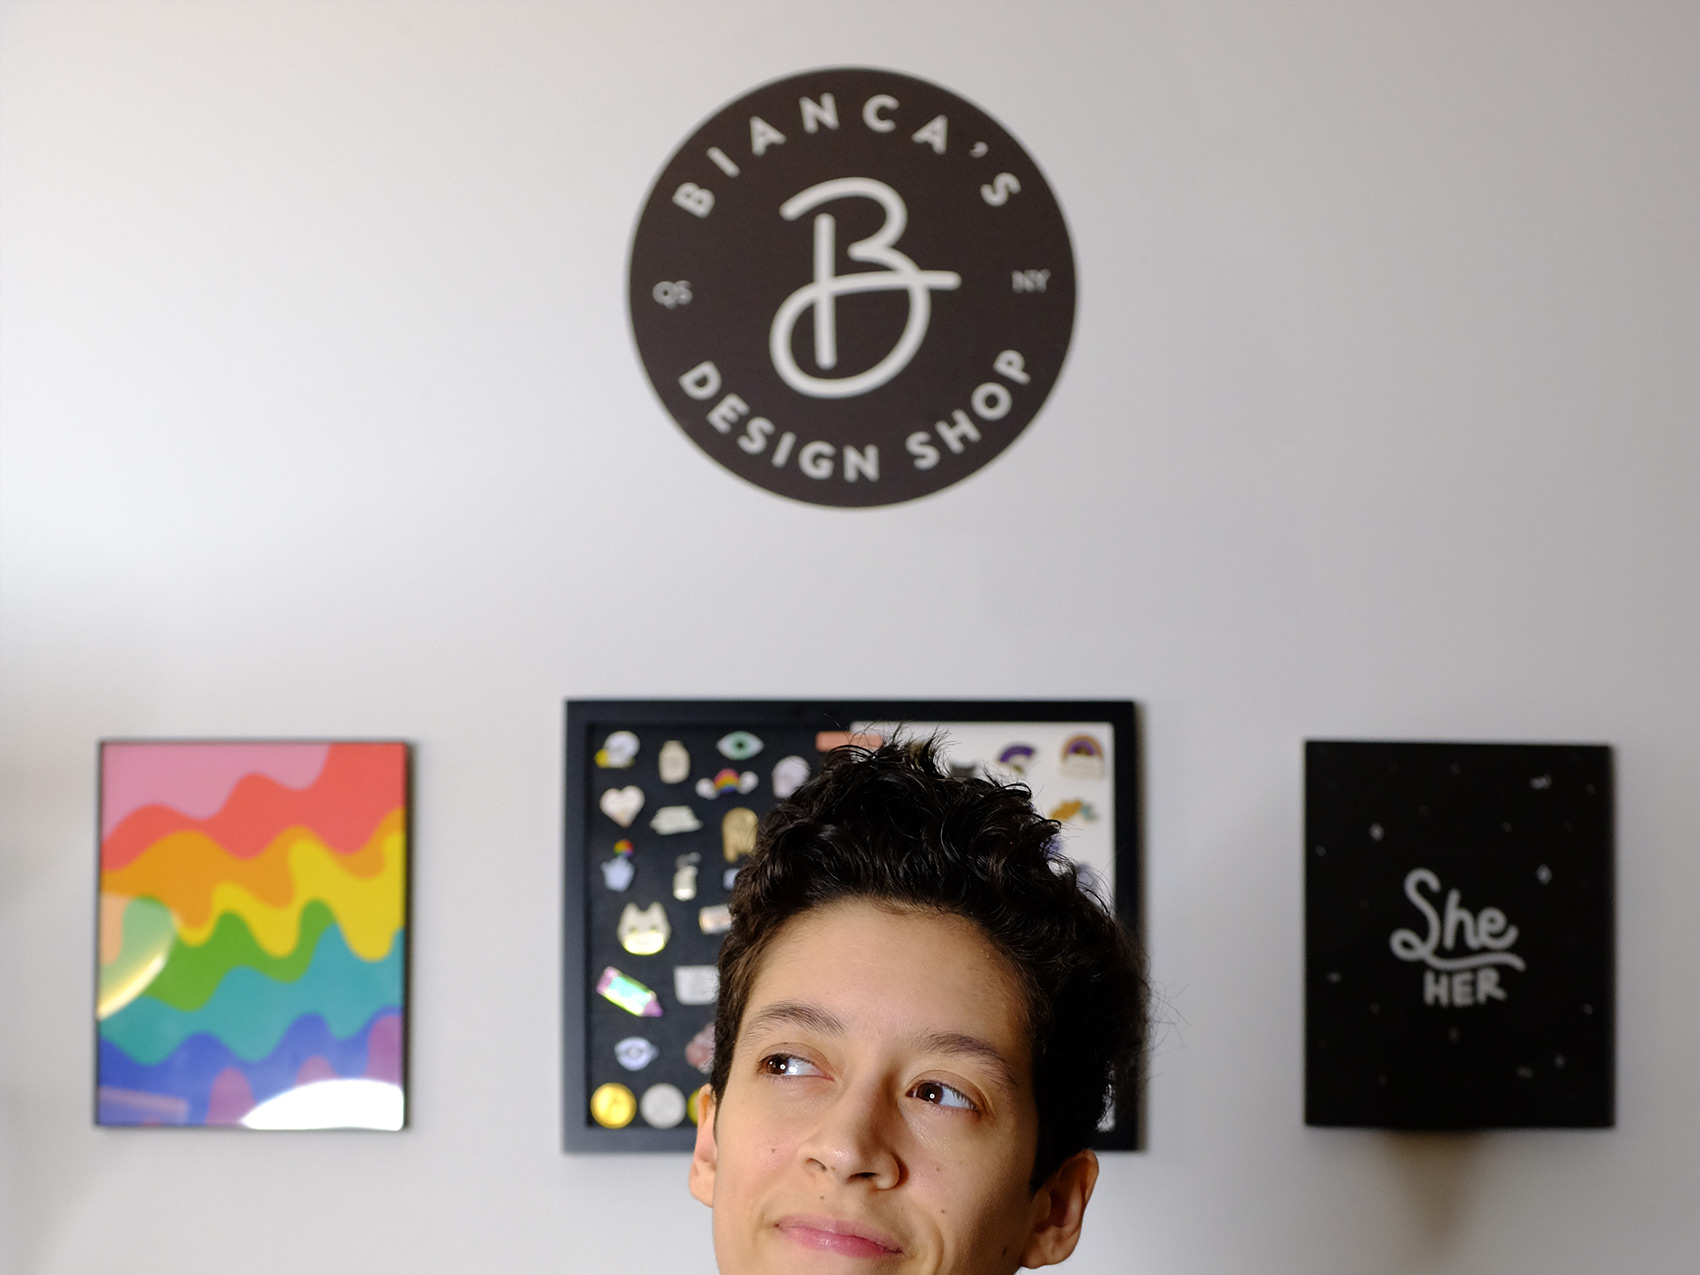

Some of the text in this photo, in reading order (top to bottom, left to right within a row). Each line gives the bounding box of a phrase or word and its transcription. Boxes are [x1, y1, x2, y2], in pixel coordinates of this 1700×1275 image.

[672, 93, 1022, 218] BIANCA'S
[769, 176, 961, 399] B
[1011, 269, 1052, 294] NY
[679, 348, 1032, 481] DESIGN SHOP
[1389, 868, 1526, 972] She
[1422, 968, 1508, 1009] HER
